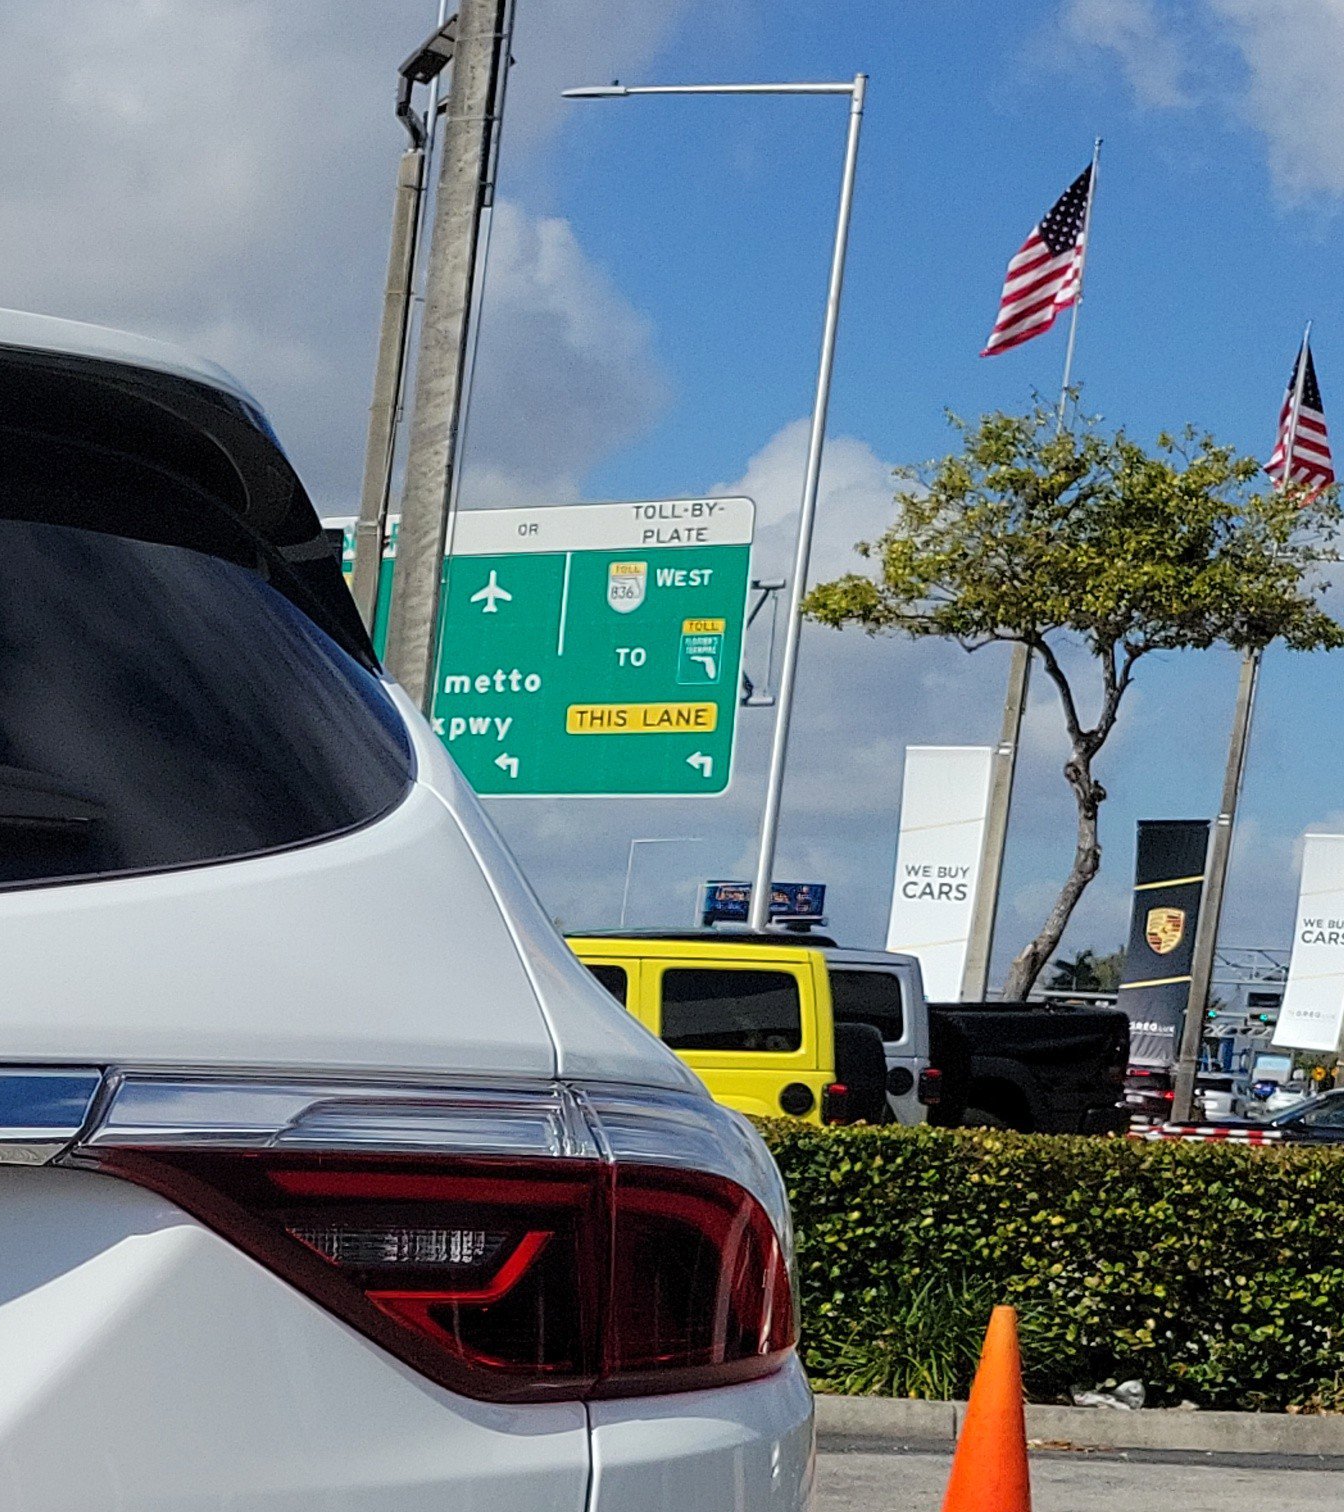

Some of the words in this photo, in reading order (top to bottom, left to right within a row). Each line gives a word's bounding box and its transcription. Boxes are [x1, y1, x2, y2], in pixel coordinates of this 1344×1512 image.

[518, 523, 539, 537] OR
[642, 527, 709, 543] PLATE
[656, 568, 713, 587] WEST
[687, 621, 720, 632] TOLL
[616, 647, 647, 667] TO
[576, 709, 628, 727] THIS
[642, 708, 707, 727] LANE
[905, 865, 932, 877] WE
[937, 866, 970, 878] BUY
[902, 881, 968, 901] CARS
[1303, 918, 1323, 928] WE
